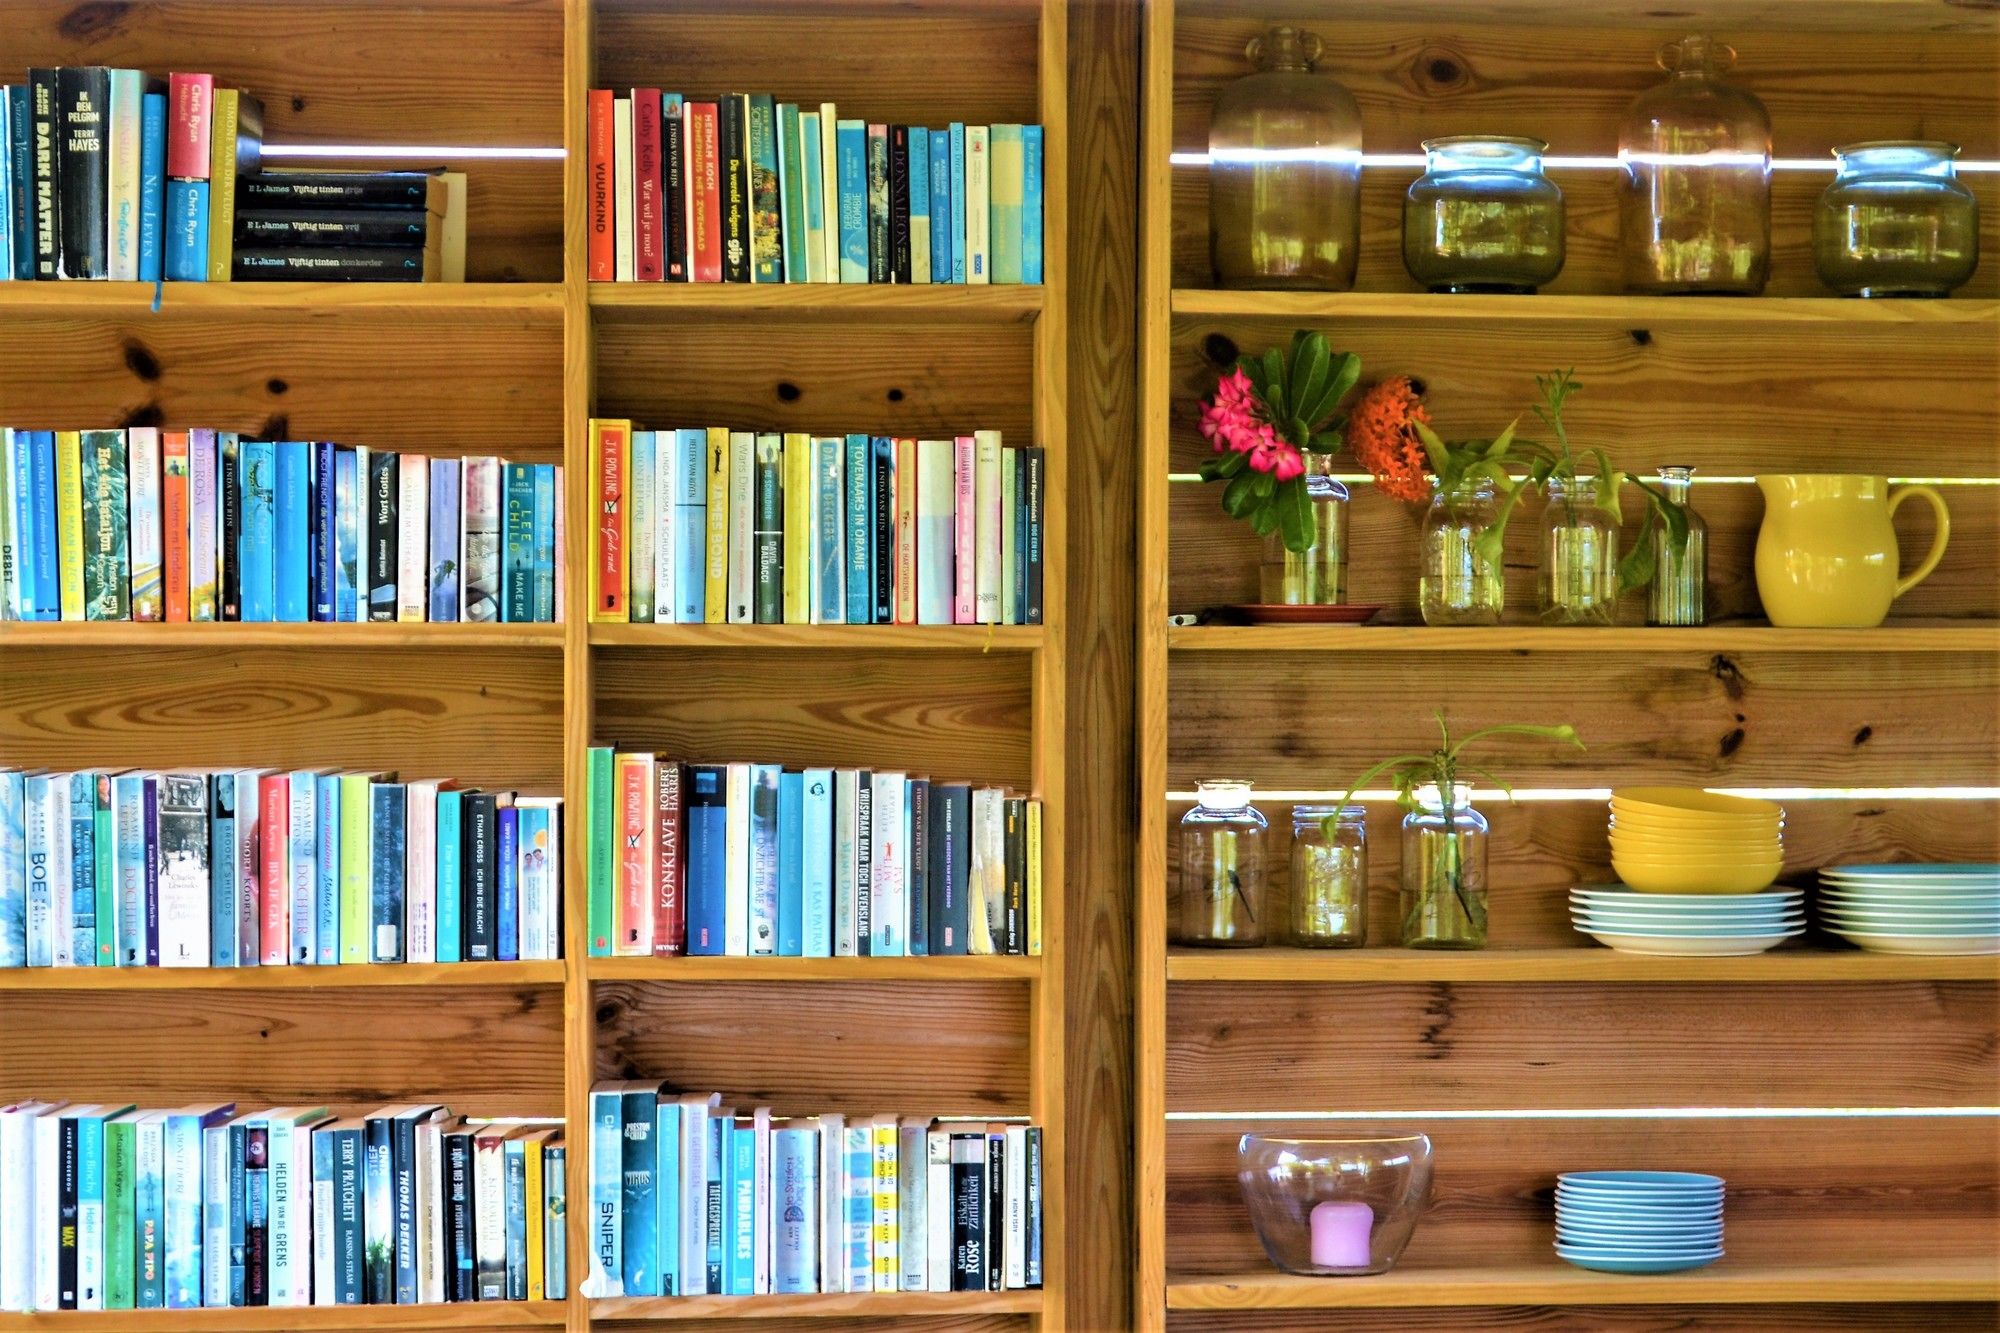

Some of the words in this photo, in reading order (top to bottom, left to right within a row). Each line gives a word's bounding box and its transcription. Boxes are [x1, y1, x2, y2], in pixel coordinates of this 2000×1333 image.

[76, 102, 92, 112] BEN
[191, 84, 201, 112] Chris
[68, 112, 100, 123] PELGRIM
[188, 115, 201, 143] Ryan
[226, 100, 235, 142] SIMONE
[640, 104, 652, 137] Cathy
[69, 138, 100, 152] HAYES
[74, 130, 95, 138] TERRY
[705, 114, 714, 158] HERMAN
[37, 122, 51, 177] DARK
[225, 145, 234, 166] VAN
[670, 168, 678, 187] RIJN
[706, 162, 715, 190] KOCH
[730, 160, 740, 171] De
[596, 163, 606, 234] VUURKIND
[643, 180, 653, 199] Wat
[696, 176, 705, 196] MET
[731, 173, 740, 202] wereld
[188, 189, 198, 216] Chris
[222, 191, 232, 226] VLUGT
[643, 203, 653, 218] wil
[853, 193, 862, 229] CROMBIE
[38, 181, 52, 254] MATTER
[262, 222, 289, 230] James
[319, 222, 344, 230] tinten
[642, 219, 653, 231] je
[696, 200, 706, 251] ZWEMBAD
[729, 205, 740, 237] volgens
[184, 219, 197, 247] Ryan
[643, 233, 654, 258] nou?
[258, 258, 285, 266] James
[62, 440, 74, 478] STEFAN
[194, 448, 205, 468] DE
[738, 444, 749, 473] Waris
[194, 471, 206, 506] ROSA
[380, 467, 389, 498] Gottes
[738, 476, 749, 501] Dirie
[854, 444, 865, 511] TOVENAARS
[878, 466, 886, 492] LINDA
[172, 493, 181, 527] Vaders
[379, 500, 388, 525] Wort
[712, 485, 723, 530] JAMES
[823, 493, 835, 541] DECKERS
[878, 494, 886, 511] VAN
[509, 500, 519, 552] CHILD
[521, 510, 532, 541] LEE
[854, 514, 865, 526] IN
[878, 512, 886, 531] RIJN
[172, 530, 180, 543] en
[854, 529, 865, 571] ORANJE
[2, 545, 13, 583] DEBET
[661, 526, 669, 588] SCHUILPLAATS
[712, 534, 723, 579] BOND
[760, 546, 770, 583] BALDACCI
[769, 541, 777, 563] DAVID
[172, 546, 181, 593] kinderen
[515, 572, 524, 600] MAKE
[516, 602, 524, 617] ME
[660, 768, 669, 810] ROBERT
[668, 768, 679, 810] HARRIS
[293, 800, 302, 846] LUPTON
[302, 790, 312, 856] ROSAMUND
[476, 814, 484, 838] ETHAN
[860, 788, 869, 837] VRIJSPRAAK
[224, 825, 232, 866] BROOKE
[476, 840, 484, 863] CROSS
[860, 839, 869, 862] MAAR
[32, 853, 46, 892] BOE
[476, 868, 484, 881] ICH
[662, 818, 675, 908] KONKLAVE
[859, 864, 869, 885] TOCH
[224, 872, 232, 917] SHIELDS
[476, 883, 484, 895] BIN
[894, 866, 903, 894] SAM
[297, 864, 308, 935] DOCHTER
[476, 896, 484, 908] DIE
[858, 886, 869, 937] LEVENSLANG
[476, 910, 484, 934] NACHT
[86, 1123, 96, 1157] Maeve
[116, 1133, 124, 1168] Marian
[342, 1138, 354, 1165] TERRY
[368, 1144, 378, 1176] STIEF
[452, 1148, 463, 1169] WORT
[84, 1160, 96, 1194] Binchy
[114, 1170, 124, 1198] Keyes
[252, 1174, 261, 1201] DENNIS
[275, 1162, 287, 1202] HELDEN
[454, 1170, 463, 1181] EIN
[624, 1171, 651, 1186] VIRUS
[342, 1170, 355, 1222] PRATCHETT
[400, 1170, 410, 1219] THOMAS
[452, 1182, 464, 1201] OHNE
[966, 1176, 979, 1230] Zärtlichkeit
[86, 1208, 96, 1234] Hotel
[252, 1202, 261, 1228] LEHANE
[277, 1206, 286, 1219] VAN
[278, 1220, 286, 1229] DE
[709, 1184, 721, 1250] TAFELGESPREKKEN
[737, 1180, 752, 1259] PANDABLUES
[958, 1194, 968, 1226] Eiskalt
[62, 1226, 75, 1247] MAX
[144, 1219, 155, 1250] PAPA
[345, 1230, 354, 1257] RAISING
[400, 1222, 410, 1269] DEKKER
[602, 1202, 614, 1267] SNIPER
[276, 1233, 287, 1268] GRENS
[958, 1246, 966, 1270] Karen
[966, 1240, 979, 1274] Rose
[144, 1252, 155, 1281] PIPO
[346, 1260, 354, 1284] STEAM
